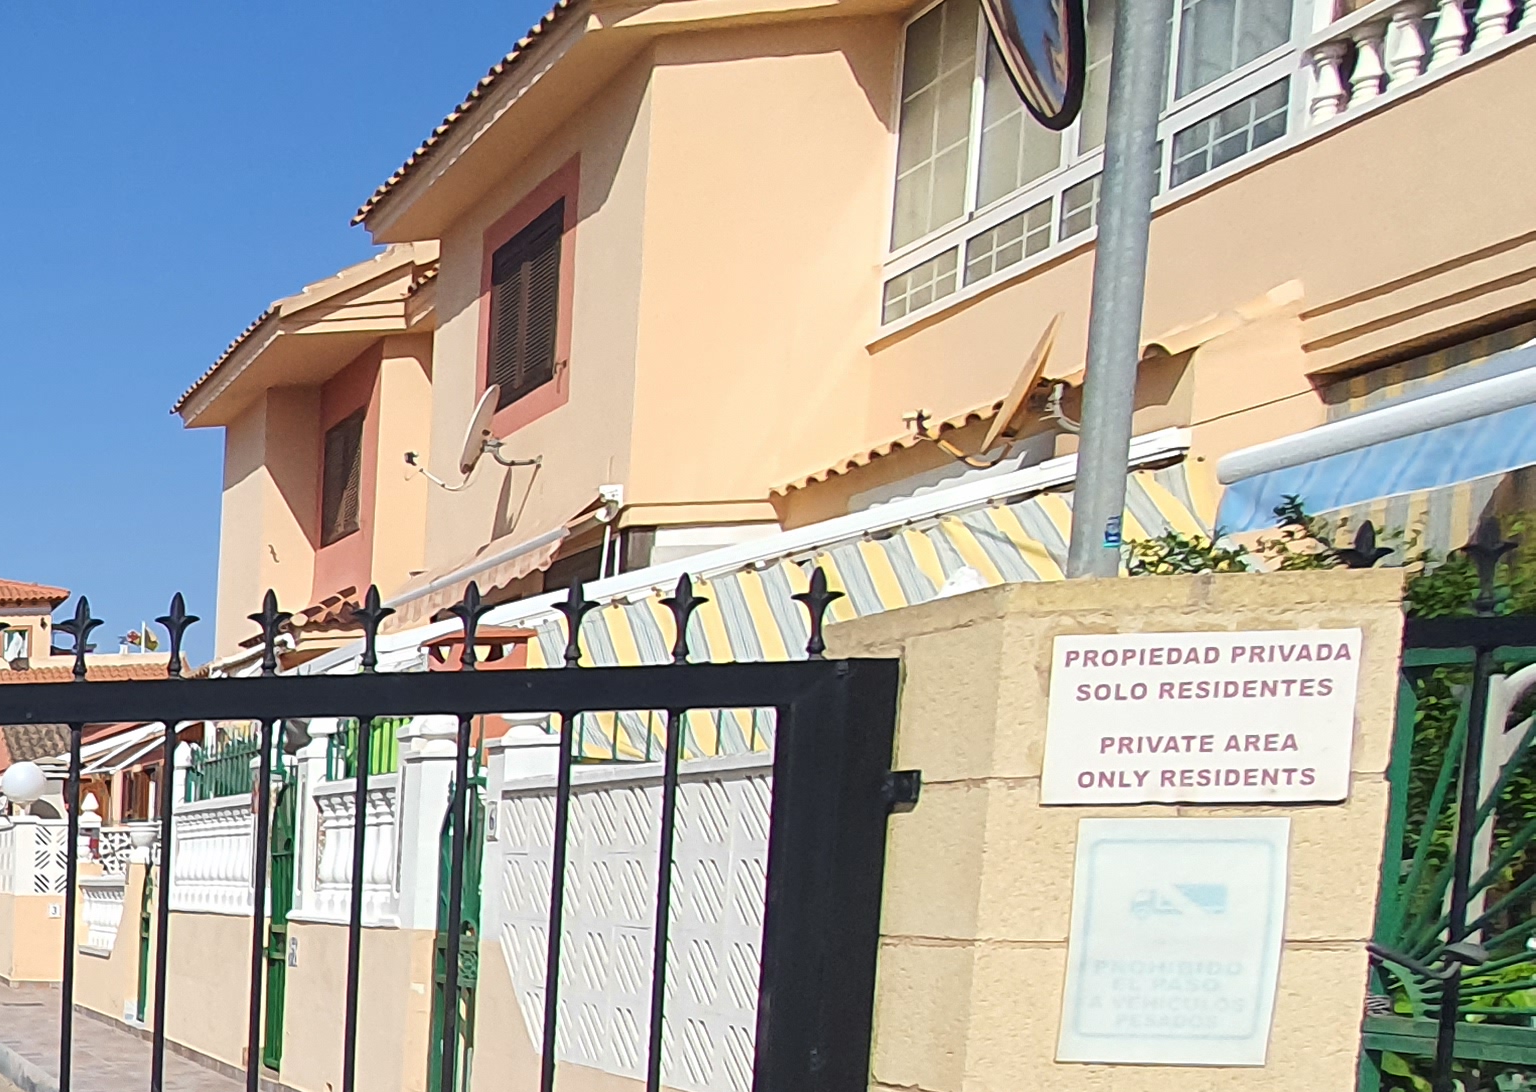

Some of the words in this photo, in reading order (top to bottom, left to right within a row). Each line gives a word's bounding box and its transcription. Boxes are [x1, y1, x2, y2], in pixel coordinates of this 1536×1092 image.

[1064, 646, 1221, 668] PROPIEDAD
[1230, 643, 1352, 663] PRIVADA
[1075, 682, 1148, 702] SOLO
[1158, 678, 1334, 700] RESIDENTES
[1099, 734, 1215, 754] PRIVATE
[1224, 733, 1299, 753] AREA
[1077, 769, 1150, 788] ONLY
[1160, 767, 1316, 788] RESIDENTS
[1094, 959, 1243, 976] PROHIBIDO
[1112, 977, 1141, 991] EL
[1152, 977, 1220, 991] PASO
[1115, 1013, 1218, 1029] PESADOS
